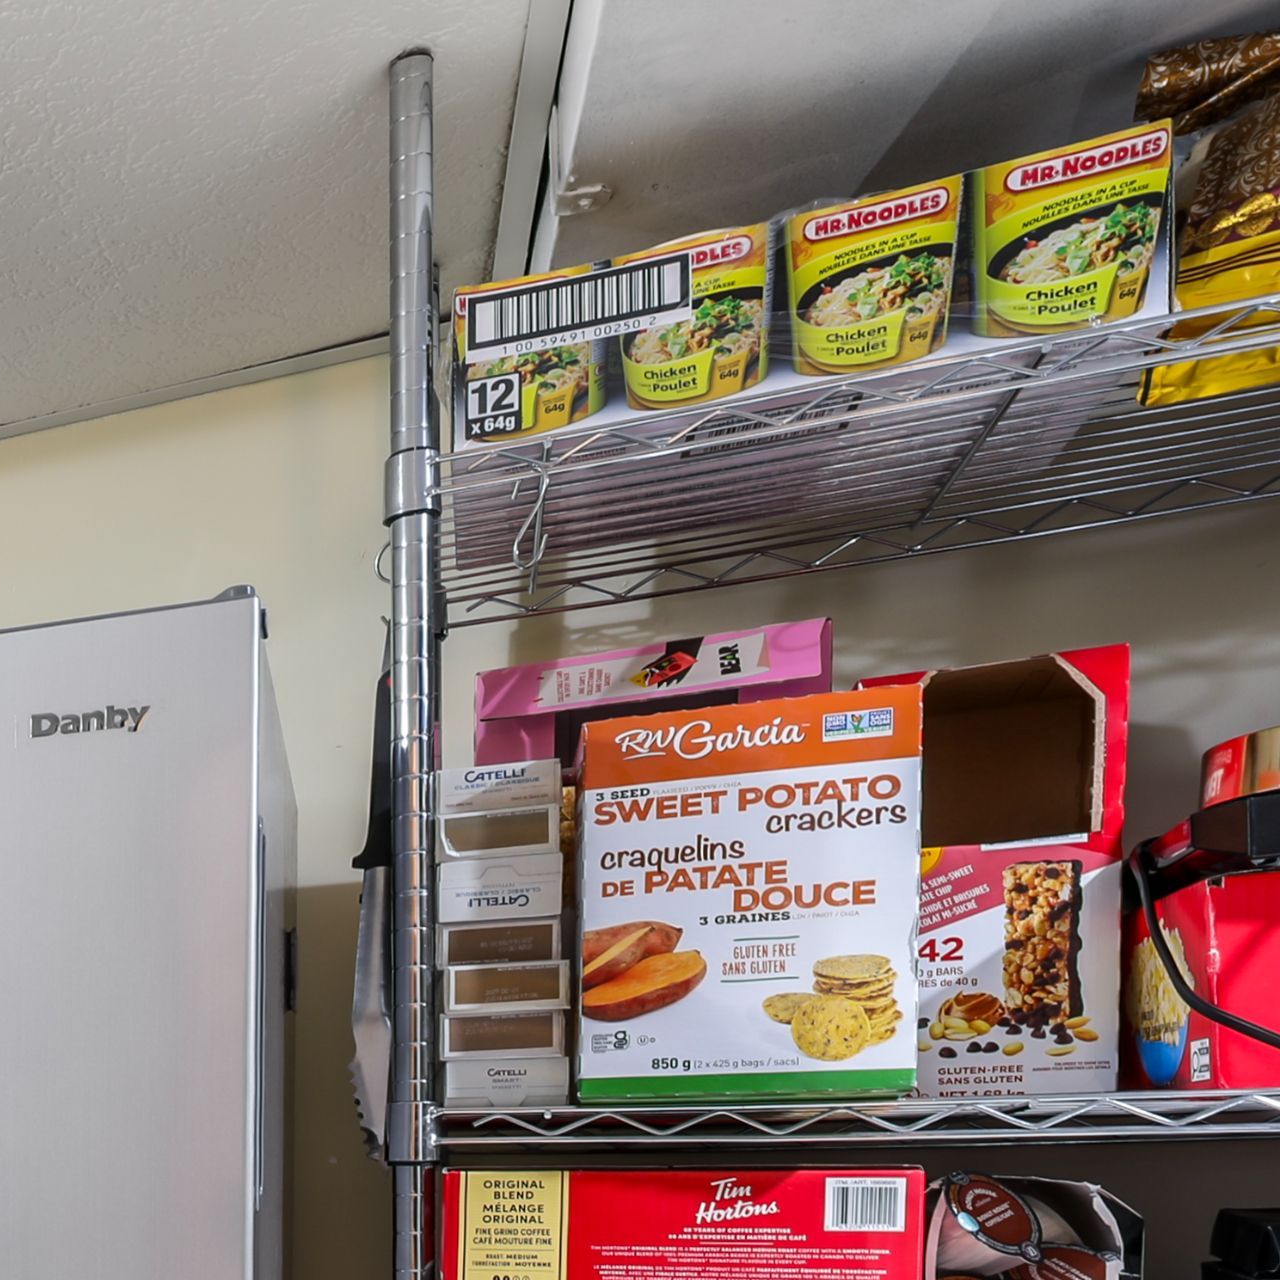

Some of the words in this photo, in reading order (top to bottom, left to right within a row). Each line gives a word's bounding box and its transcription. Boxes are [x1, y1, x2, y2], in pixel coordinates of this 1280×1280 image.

[1061, 136, 1163, 177] NOODLES
[1042, 193, 1093, 213] NOODLES
[1096, 186, 1107, 196] IN
[1109, 184, 1117, 192] A
[1119, 179, 1137, 189] CUP
[847, 194, 941, 229] NOODLES
[1022, 207, 1070, 229] NOUILLES
[1072, 198, 1103, 211] DANS
[1105, 190, 1124, 200] UNE
[1127, 183, 1150, 195] TASSE
[834, 243, 876, 261] NOODLES
[878, 239, 889, 249] IN
[900, 232, 917, 243] CUP
[818, 256, 857, 276] NOUILLES
[859, 248, 886, 261] DANS
[1025, 280, 1098, 302] Chicken
[1119, 287, 1137, 300] 64g
[1037, 296, 1096, 316] Poulet
[515, 340, 533, 353] 00
[540, 330, 587, 347] 59491
[593, 318, 642, 338] 00250
[648, 315, 658, 326] 2
[825, 325, 888, 343] Chicken
[909, 330, 928, 343] 64g
[835, 339, 888, 357] Poulet
[643, 362, 697, 380] Chicken
[719, 367, 739, 380] 64g
[651, 376, 697, 394] Poulet
[470, 378, 515, 416] 12
[544, 401, 565, 415] 64g
[470, 423, 481, 435] x
[483, 415, 516, 432] 64g
[30, 705, 151, 738] Danby
[593, 790, 729, 826] SWEET
[737, 773, 902, 813] POTATO
[595, 792, 606, 802] 3
[609, 787, 651, 801] SEED
[765, 800, 908, 834] crackers
[599, 833, 746, 875] craquelins
[601, 880, 635, 899] DE
[644, 859, 788, 895] PATATE
[929, 864, 975, 889] SEMI-SWEET
[732, 879, 877, 913] DOUCE
[935, 884, 953, 897] CHIP
[953, 883, 990, 904] BRISURES
[467, 895, 530, 909] CATELLI
[698, 916, 709, 927] 3
[714, 911, 791, 926] GRAINES
[732, 945, 769, 959] GLUTEN
[772, 943, 797, 958] FREE
[918, 936, 964, 963] 42
[721, 962, 747, 976] SANS
[749, 960, 786, 974] GLUTEN
[936, 966, 964, 977] BARS
[940, 979, 953, 988] de
[954, 977, 969, 987] 40
[487, 1067, 527, 1078] CATELLI
[650, 1057, 678, 1071] 850
[681, 1059, 691, 1072] g
[712, 1058, 731, 1069] 425
[740, 1056, 765, 1069] bags
[773, 1055, 800, 1067] sacs)
[937, 1064, 1024, 1077] GLUTEN-FREE
[937, 1076, 970, 1086] SANS
[973, 1074, 1024, 1085] GLUTEN
[482, 1179, 545, 1190] ORIGINAL
[709, 1176, 752, 1201] Tim
[493, 1190, 535, 1200] BLEND
[482, 1201, 545, 1214] MÉLANGE
[695, 1199, 780, 1225] Hortons
[482, 1214, 544, 1224] ORIGINAL
[472, 1234, 493, 1245] CAFÉ
[494, 1237, 534, 1245] MOUTURE
[534, 1237, 553, 1245] FINE
[475, 1227, 492, 1236] FINE
[493, 1227, 519, 1236] GRIND
[520, 1227, 551, 1237] COFFEE
